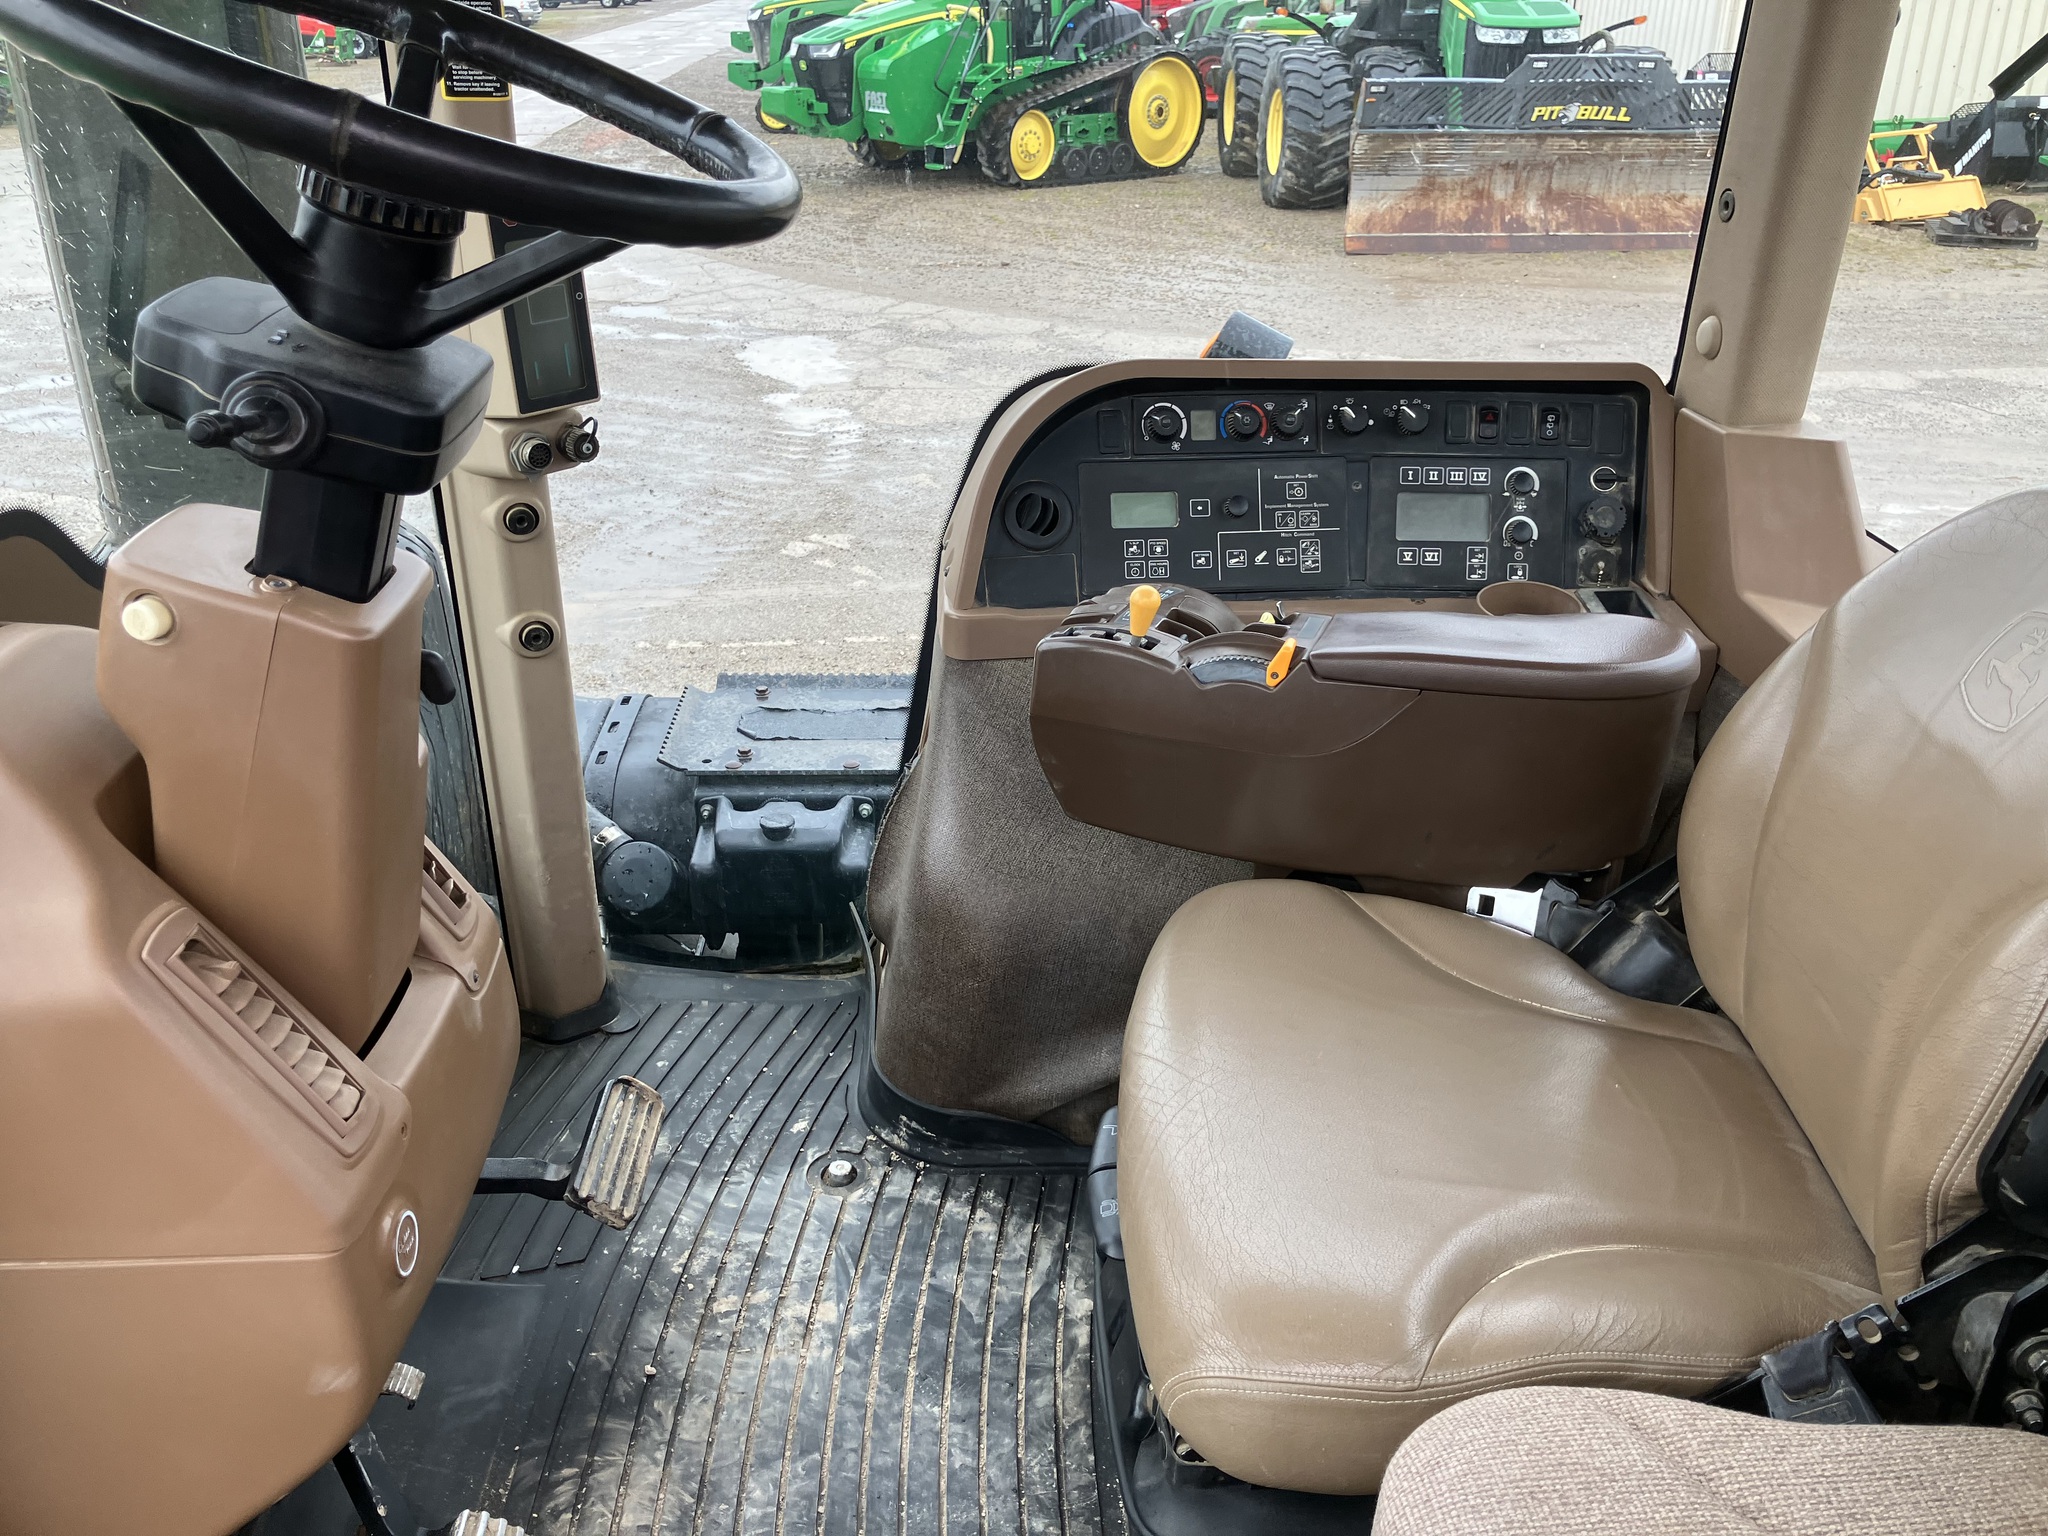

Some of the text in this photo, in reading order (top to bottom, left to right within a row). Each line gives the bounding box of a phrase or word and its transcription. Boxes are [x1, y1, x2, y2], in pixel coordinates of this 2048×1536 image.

[865, 91, 888, 111] FAST
[1531, 106, 1632, 122] PIT BULL
[1961, 128, 1992, 167] MANITOU
[1408, 471, 1414, 480] I
[1429, 471, 1438, 480] II
[1450, 472, 1464, 481] III
[1473, 472, 1487, 481] IV
[1403, 552, 1413, 561] V
[1424, 552, 1438, 561] VI
